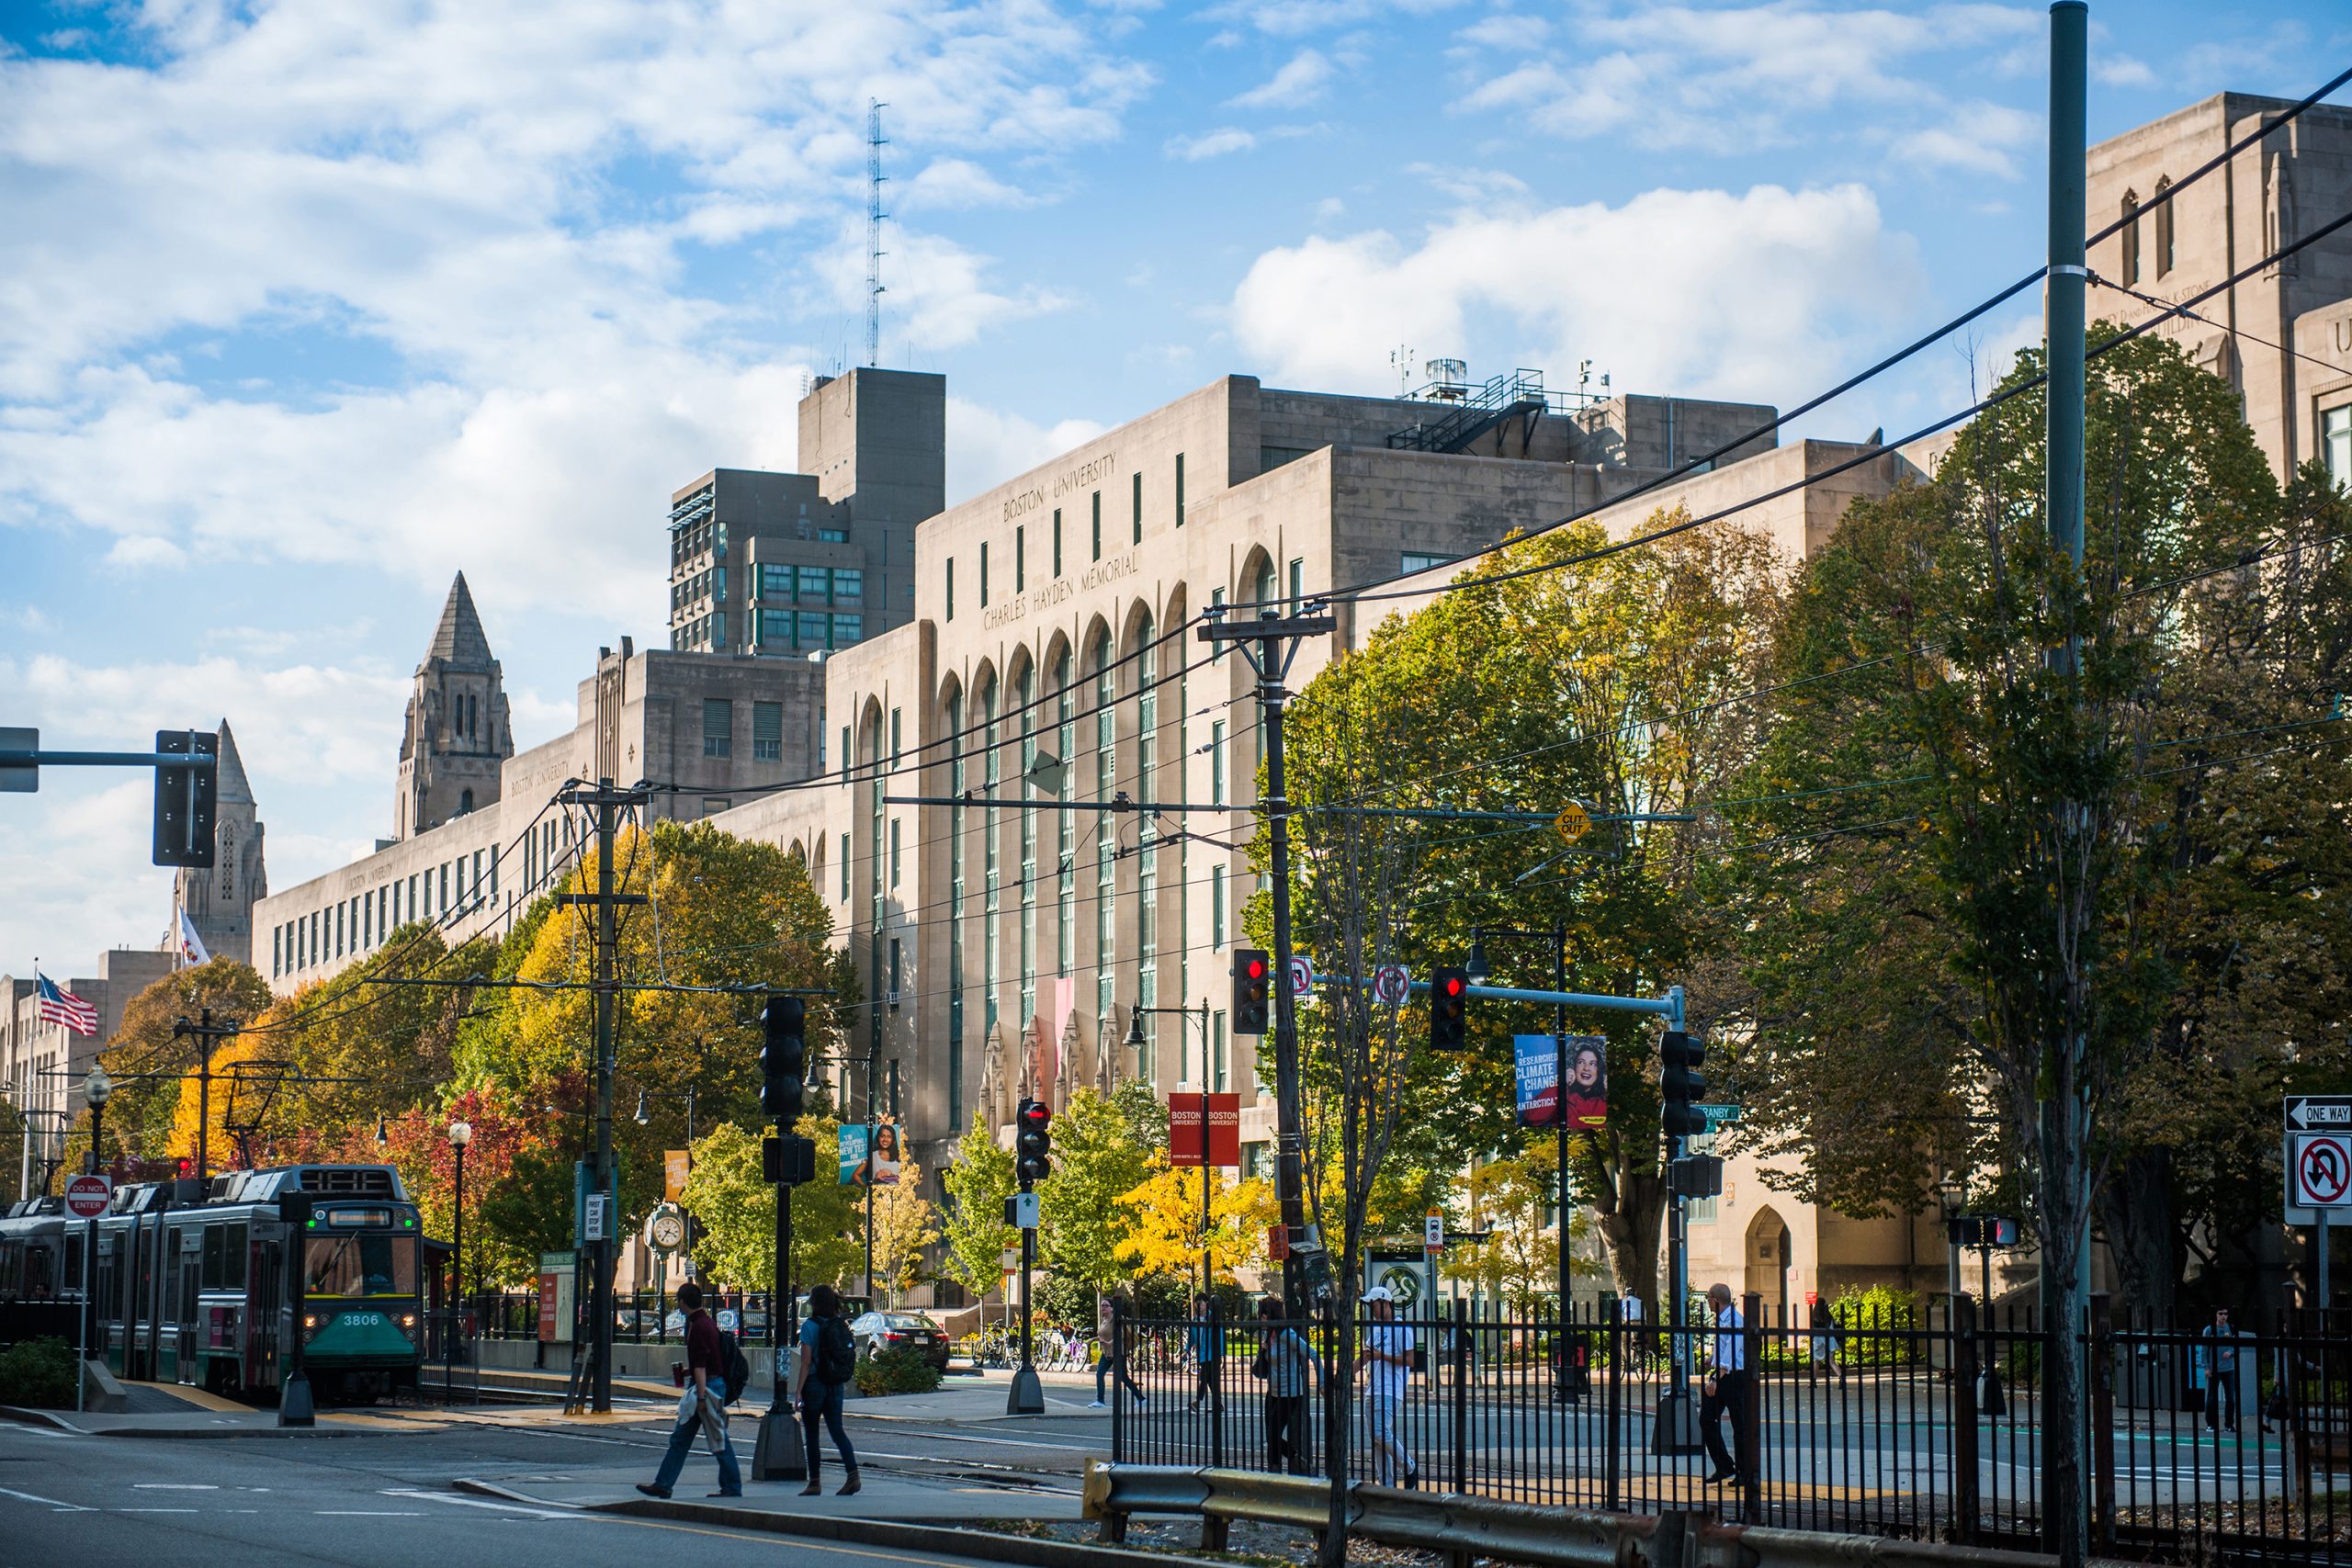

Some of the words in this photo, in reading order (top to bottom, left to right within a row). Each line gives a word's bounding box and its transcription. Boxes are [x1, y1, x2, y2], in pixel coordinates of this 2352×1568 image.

[1003, 485, 1044, 523] BOSTON
[1053, 451, 1116, 498] UNIVERSITY
[984, 596, 1026, 632] CHARLES
[1034, 576, 1073, 613] HAYDEN
[1080, 551, 1138, 593] MEMORIAL
[512, 775, 533, 797] BOSTON
[537, 761, 569, 787] UNIVERSITY
[1562, 814, 1584, 824] CUT
[1562, 824, 1583, 834] OUT
[1518, 1053, 1559, 1067] RESEARCHED
[1515, 1063, 1555, 1080] CLIMATE
[1525, 1091, 1533, 1100] IN
[1171, 1111, 1202, 1120] BOSTON
[1208, 1111, 1238, 1120] BOSTON
[1702, 1107, 1729, 1118] RANBY
[2306, 1107, 2325, 1121] ONE
[2329, 1107, 2349, 1121] WAY
[840, 1145, 853, 1156] NEW
[344, 1314, 379, 1325] 3806
